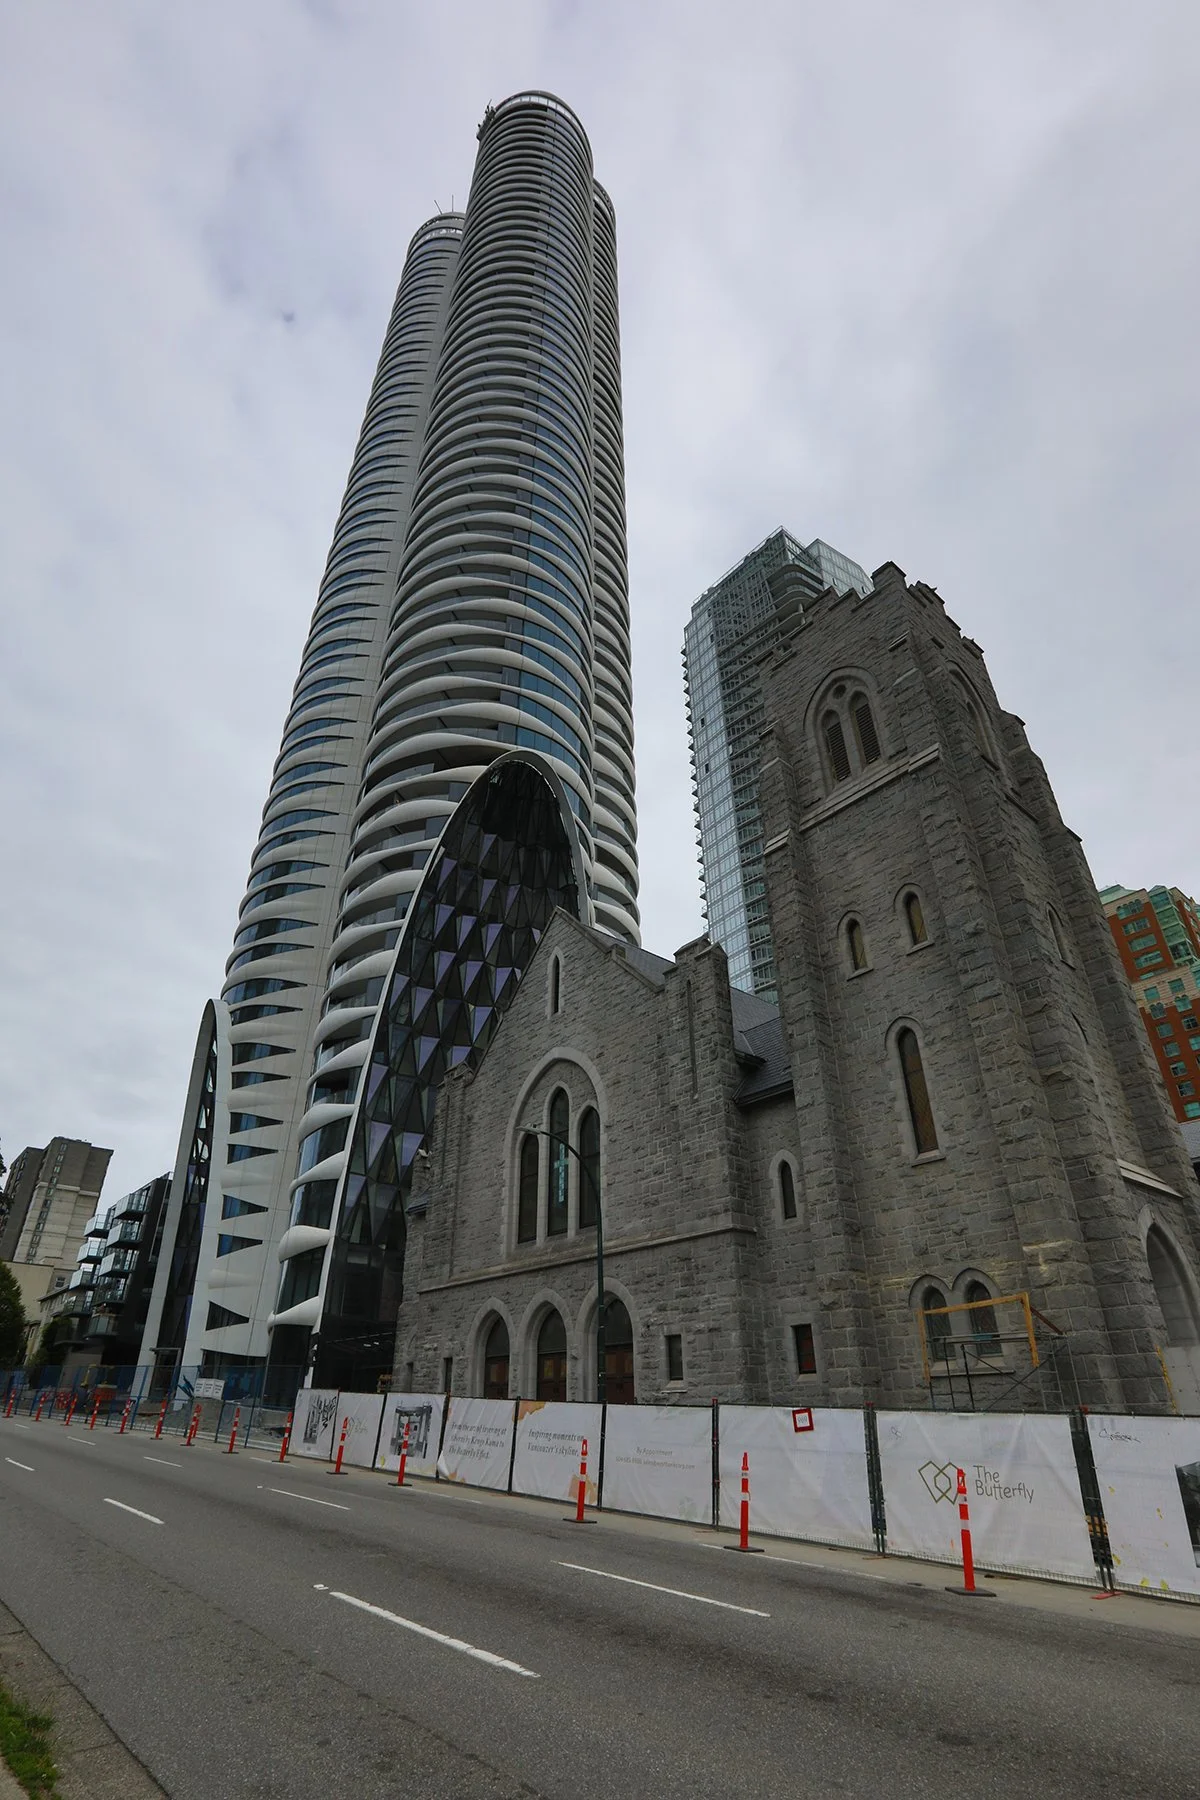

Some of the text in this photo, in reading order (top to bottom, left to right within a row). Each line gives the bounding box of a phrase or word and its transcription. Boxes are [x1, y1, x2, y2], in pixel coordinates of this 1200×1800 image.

[528, 1428, 552, 1442] Inspiring
[552, 1432, 576, 1442] moments
[527, 1442, 558, 1454] Vancouver's
[642, 1447, 673, 1456] Appointment
[973, 1464, 1000, 1484] The
[975, 1479, 1034, 1504] Butterfly
